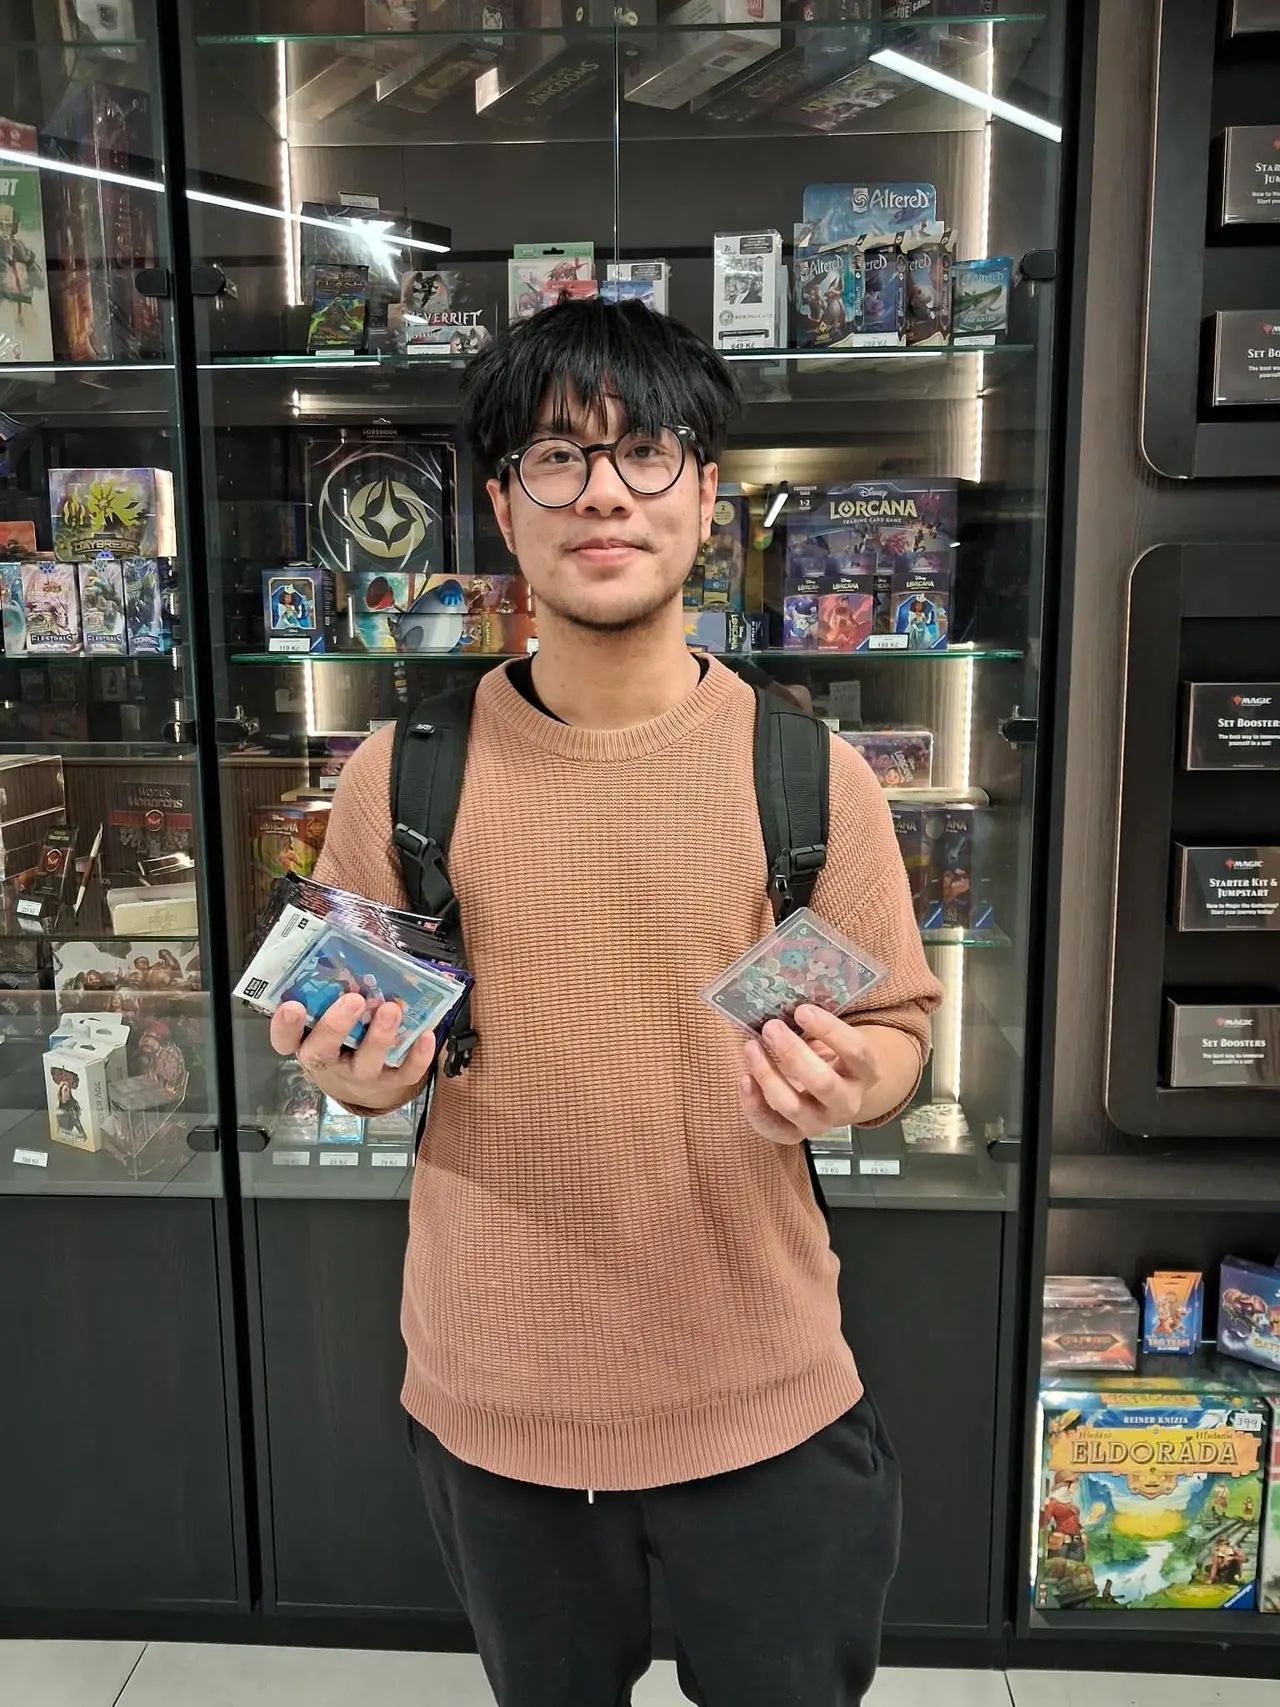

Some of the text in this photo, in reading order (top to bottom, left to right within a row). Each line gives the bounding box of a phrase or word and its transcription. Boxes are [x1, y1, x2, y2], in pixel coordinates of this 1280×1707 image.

[858, 486, 889, 499] Disney
[829, 499, 918, 521] LORCANA
[843, 517, 868, 525] TRADING
[73, 541, 140, 552] DAYBREAK
[832, 582, 859, 590] LORCANA
[906, 580, 935, 588] LORCANA
[730, 613, 739, 650] LORCANA
[1241, 697, 1273, 705] MAGIC
[1217, 717, 1236, 728] SET
[1234, 860, 1264, 868] MAGIC
[1209, 878, 1278, 887] STARTER KIT &
[1217, 888, 1269, 898] JUMPSTART
[1202, 1038, 1267, 1048] SET BOOSTERS
[1123, 1415, 1189, 1424] REINER KNIZIA
